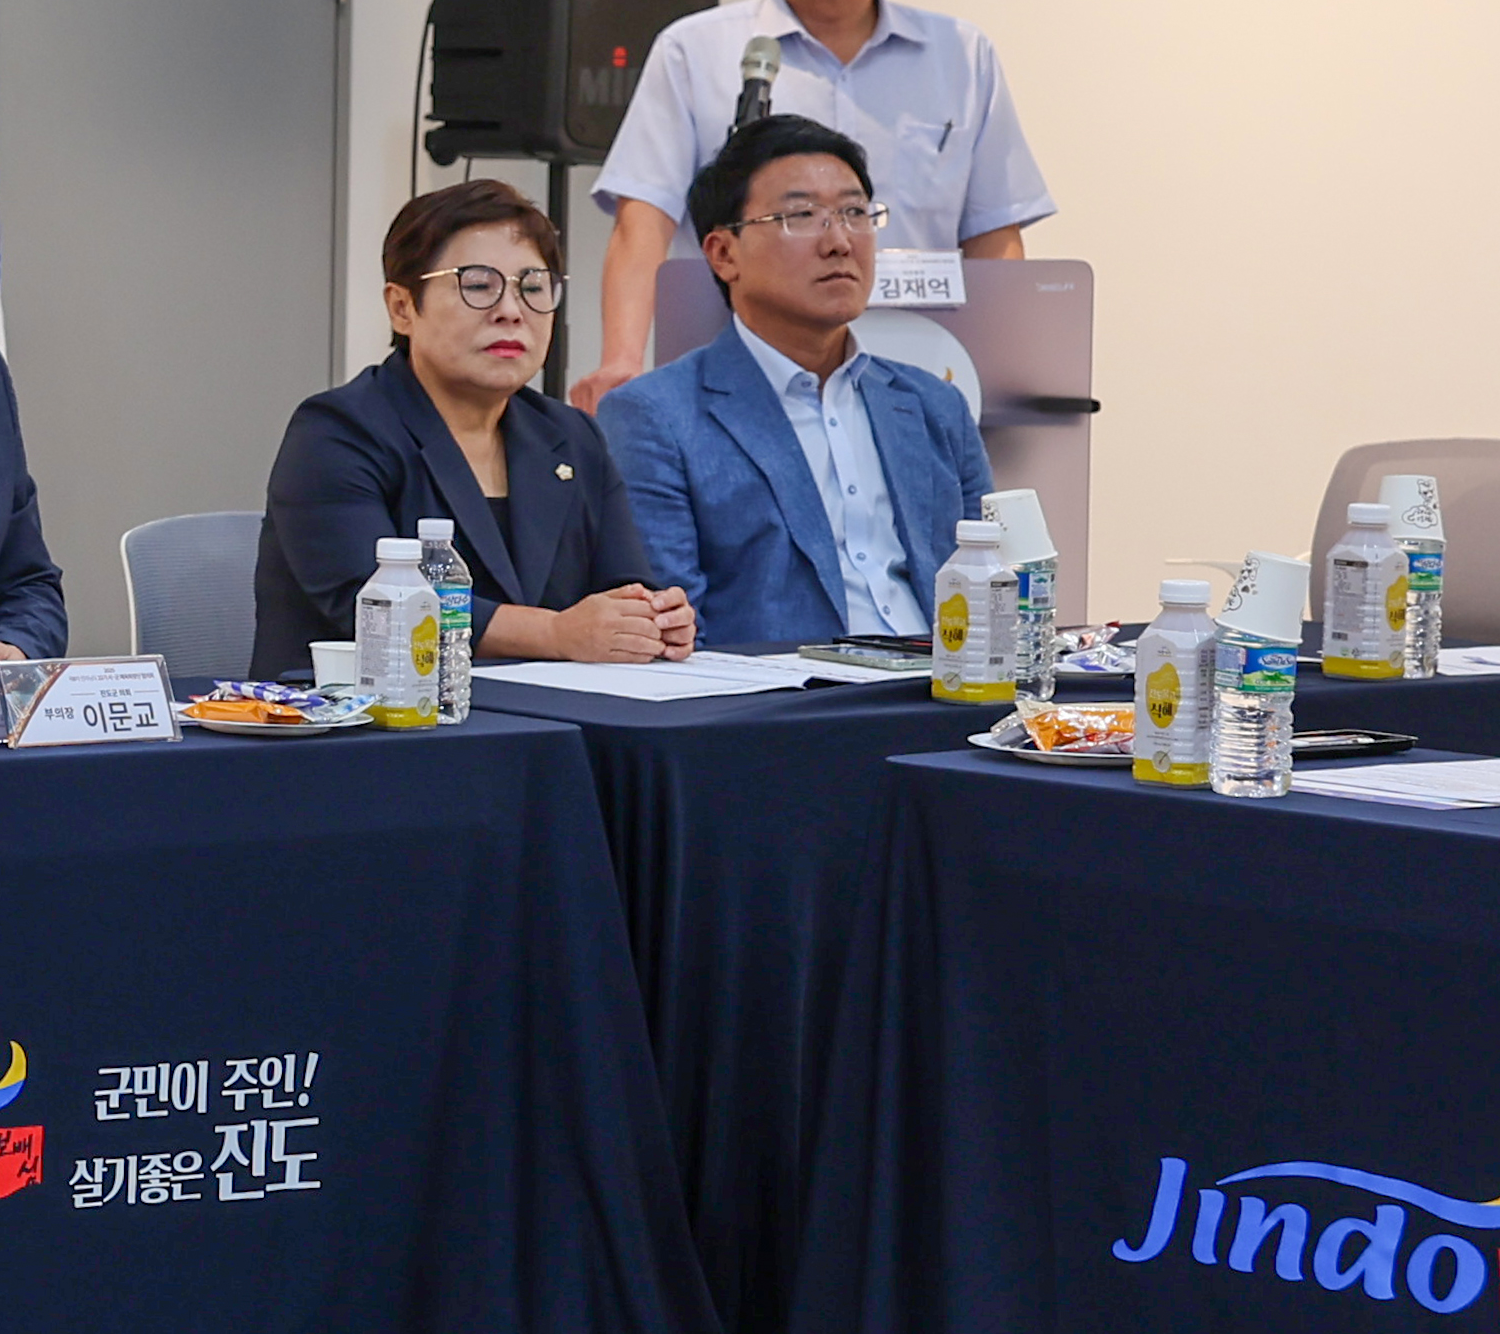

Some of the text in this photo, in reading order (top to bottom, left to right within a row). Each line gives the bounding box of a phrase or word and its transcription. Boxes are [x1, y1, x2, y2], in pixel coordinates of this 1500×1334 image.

[879, 277, 951, 300] 김재억
[44, 701, 159, 734] 부의장 이문교
[1150, 701, 1173, 719] 식혜
[94, 1052, 320, 1121] 군민이 주인!
[68, 1117, 321, 1209] 살기좋은 진도
[1111, 1157, 1489, 1315] Jindo
